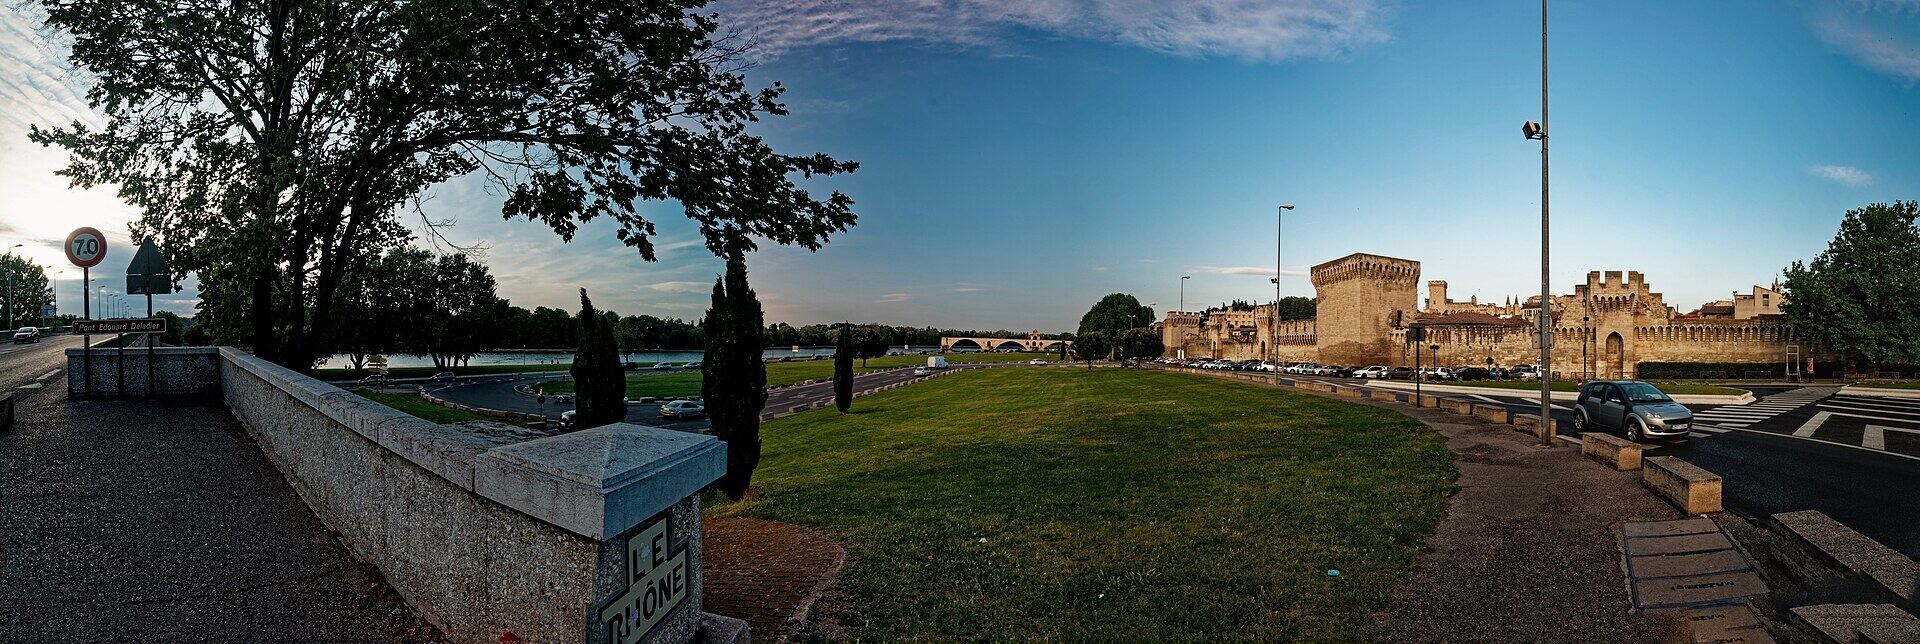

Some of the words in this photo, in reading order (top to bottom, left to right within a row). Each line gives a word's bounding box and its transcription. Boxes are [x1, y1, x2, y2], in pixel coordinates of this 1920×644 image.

[99, 323, 127, 331] Edouard
[131, 322, 160, 330] Daladier
[633, 532, 664, 583] LE
[607, 562, 683, 644] RHÔNE
